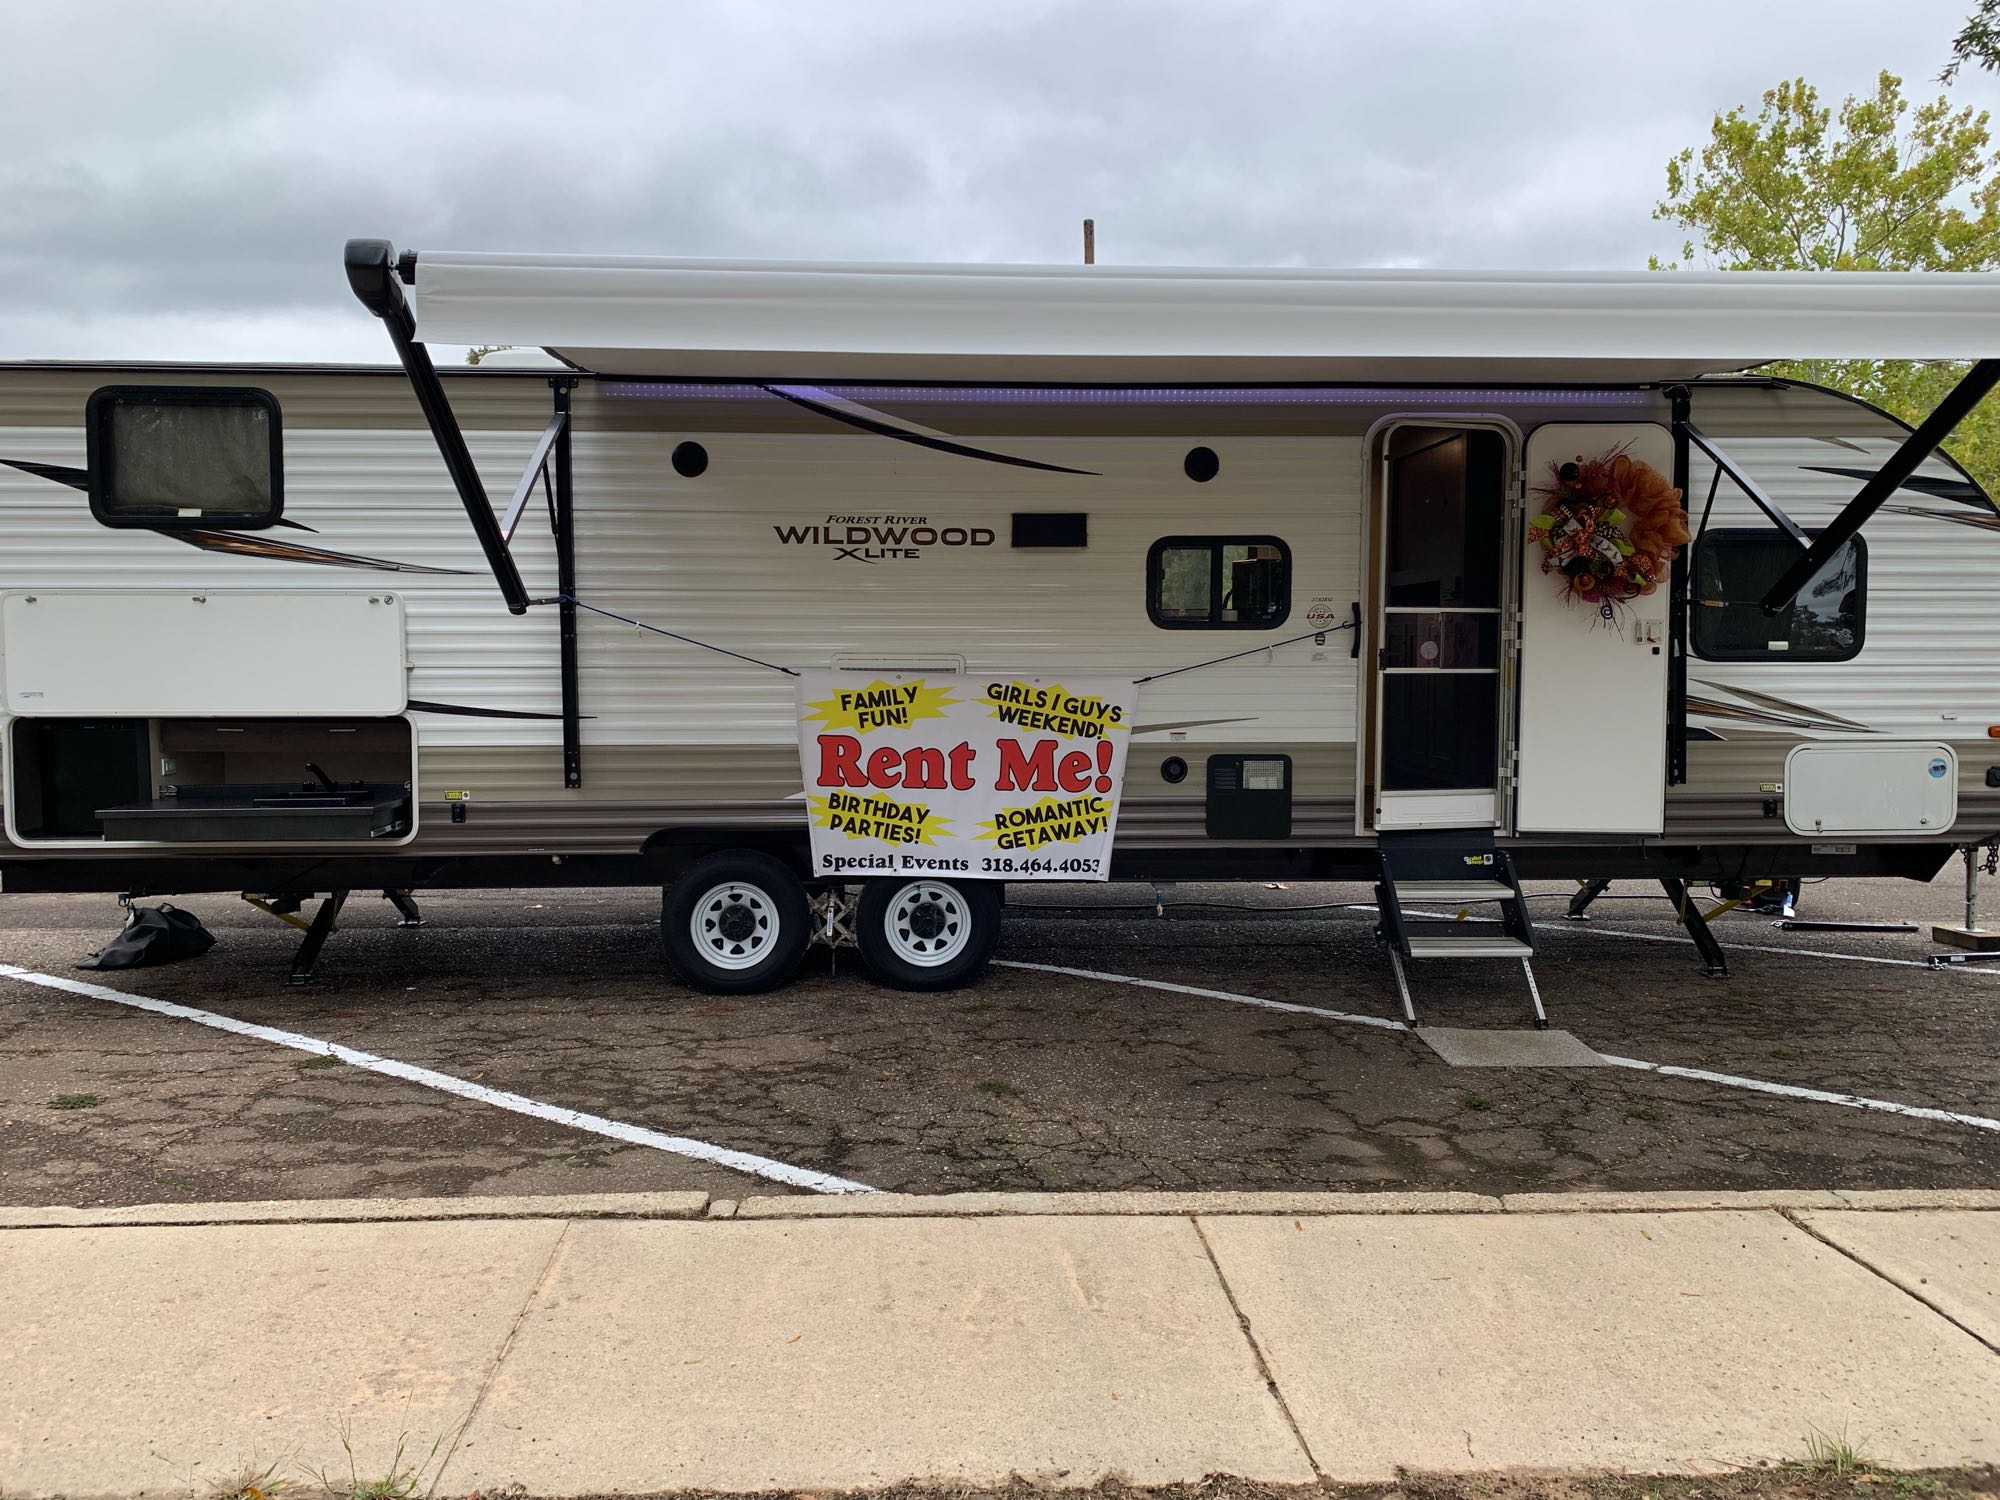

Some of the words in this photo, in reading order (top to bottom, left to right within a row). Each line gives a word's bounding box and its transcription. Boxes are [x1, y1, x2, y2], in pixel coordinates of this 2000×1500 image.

[825, 514, 881, 525] FOREST
[885, 515, 928, 525] RIVER
[773, 526, 996, 546] WILDWOOD
[840, 685, 918, 711] FAMILY
[986, 683, 1048, 709] GIRLS
[1063, 697, 1123, 723] GUYS
[858, 707, 908, 729] FUN!
[997, 704, 1104, 740] WEEKEND!
[817, 734, 976, 790] Rent
[994, 738, 1113, 793] Me!
[828, 792, 930, 825] BIRTHDAY
[994, 797, 1104, 830] ROMANTIC
[829, 813, 921, 845] PARTIES!
[997, 816, 1108, 850] GETAWAY!
[822, 854, 894, 873] Special
[901, 855, 969, 871] Events
[981, 857, 1099, 873] 318.464.4053
